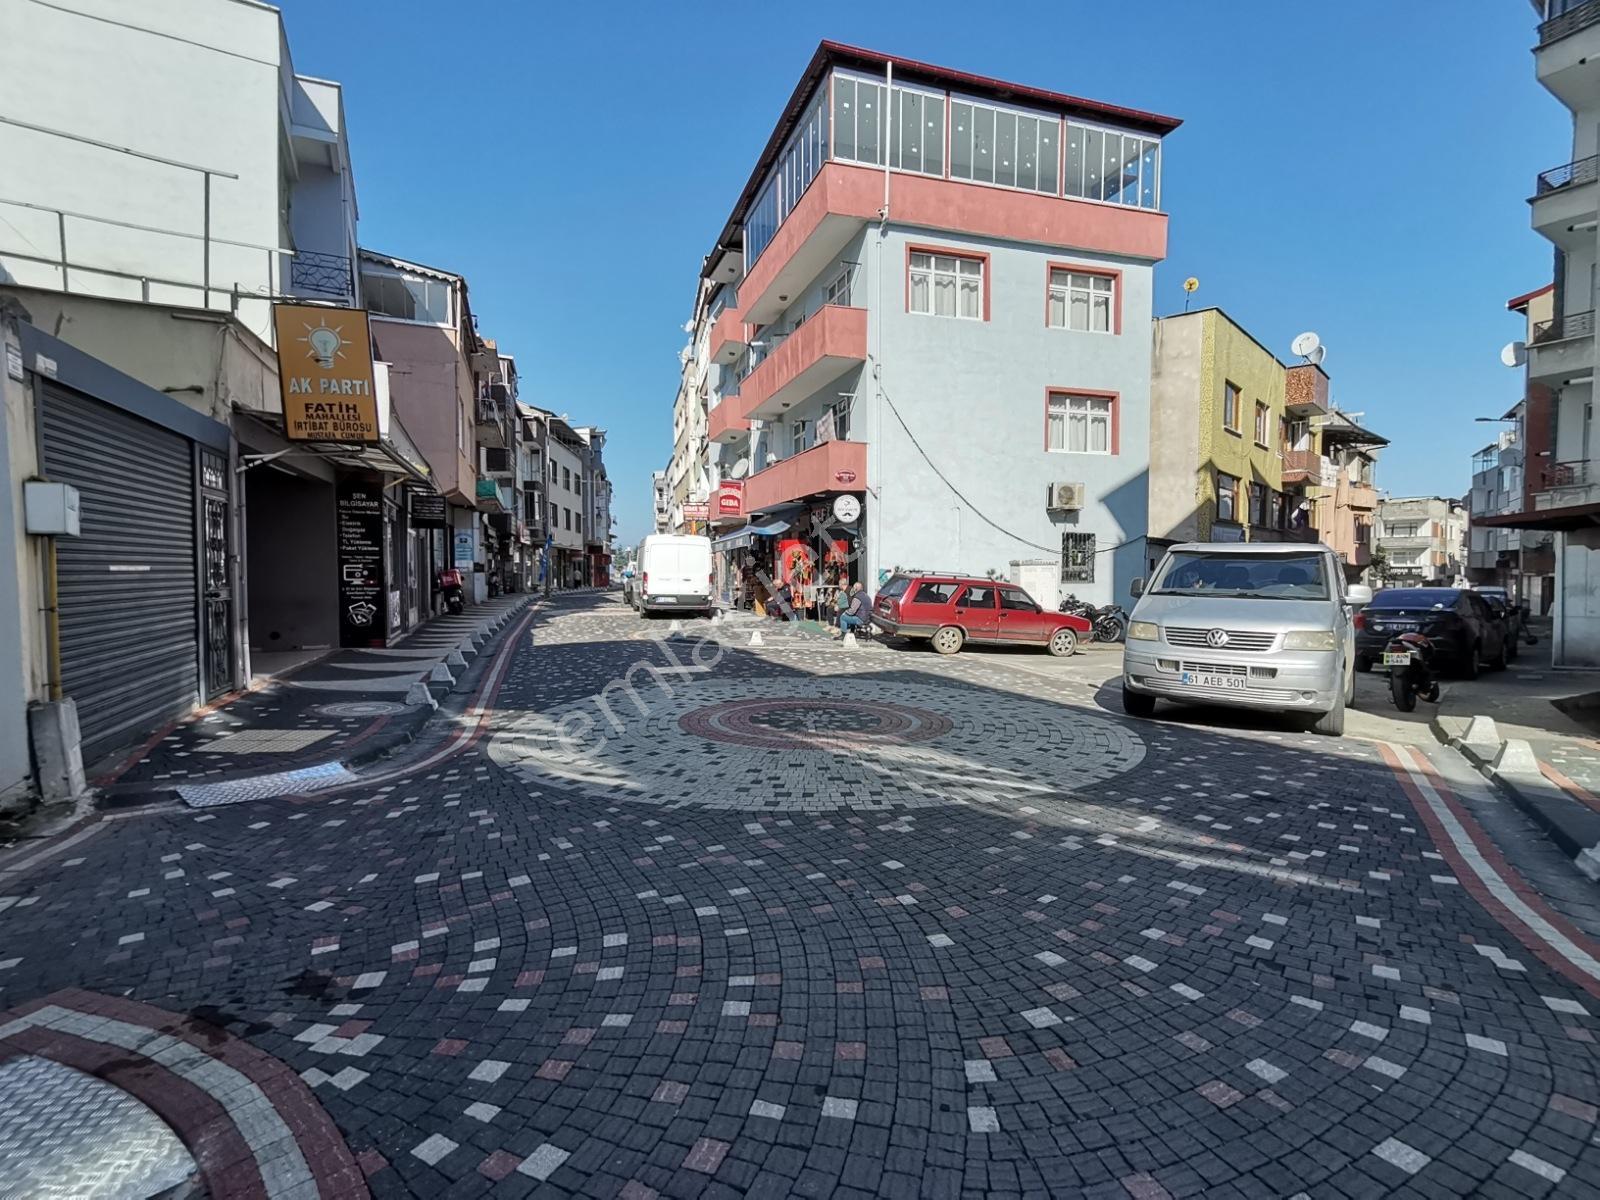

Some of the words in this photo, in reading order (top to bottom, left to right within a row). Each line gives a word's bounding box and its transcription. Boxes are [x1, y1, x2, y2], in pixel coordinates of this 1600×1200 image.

[289, 377, 312, 394] AK
[304, 401, 358, 413] FATİH
[1188, 674, 1198, 684] 61
[1203, 676, 1224, 686] AEB
[1226, 678, 1245, 688] 501
